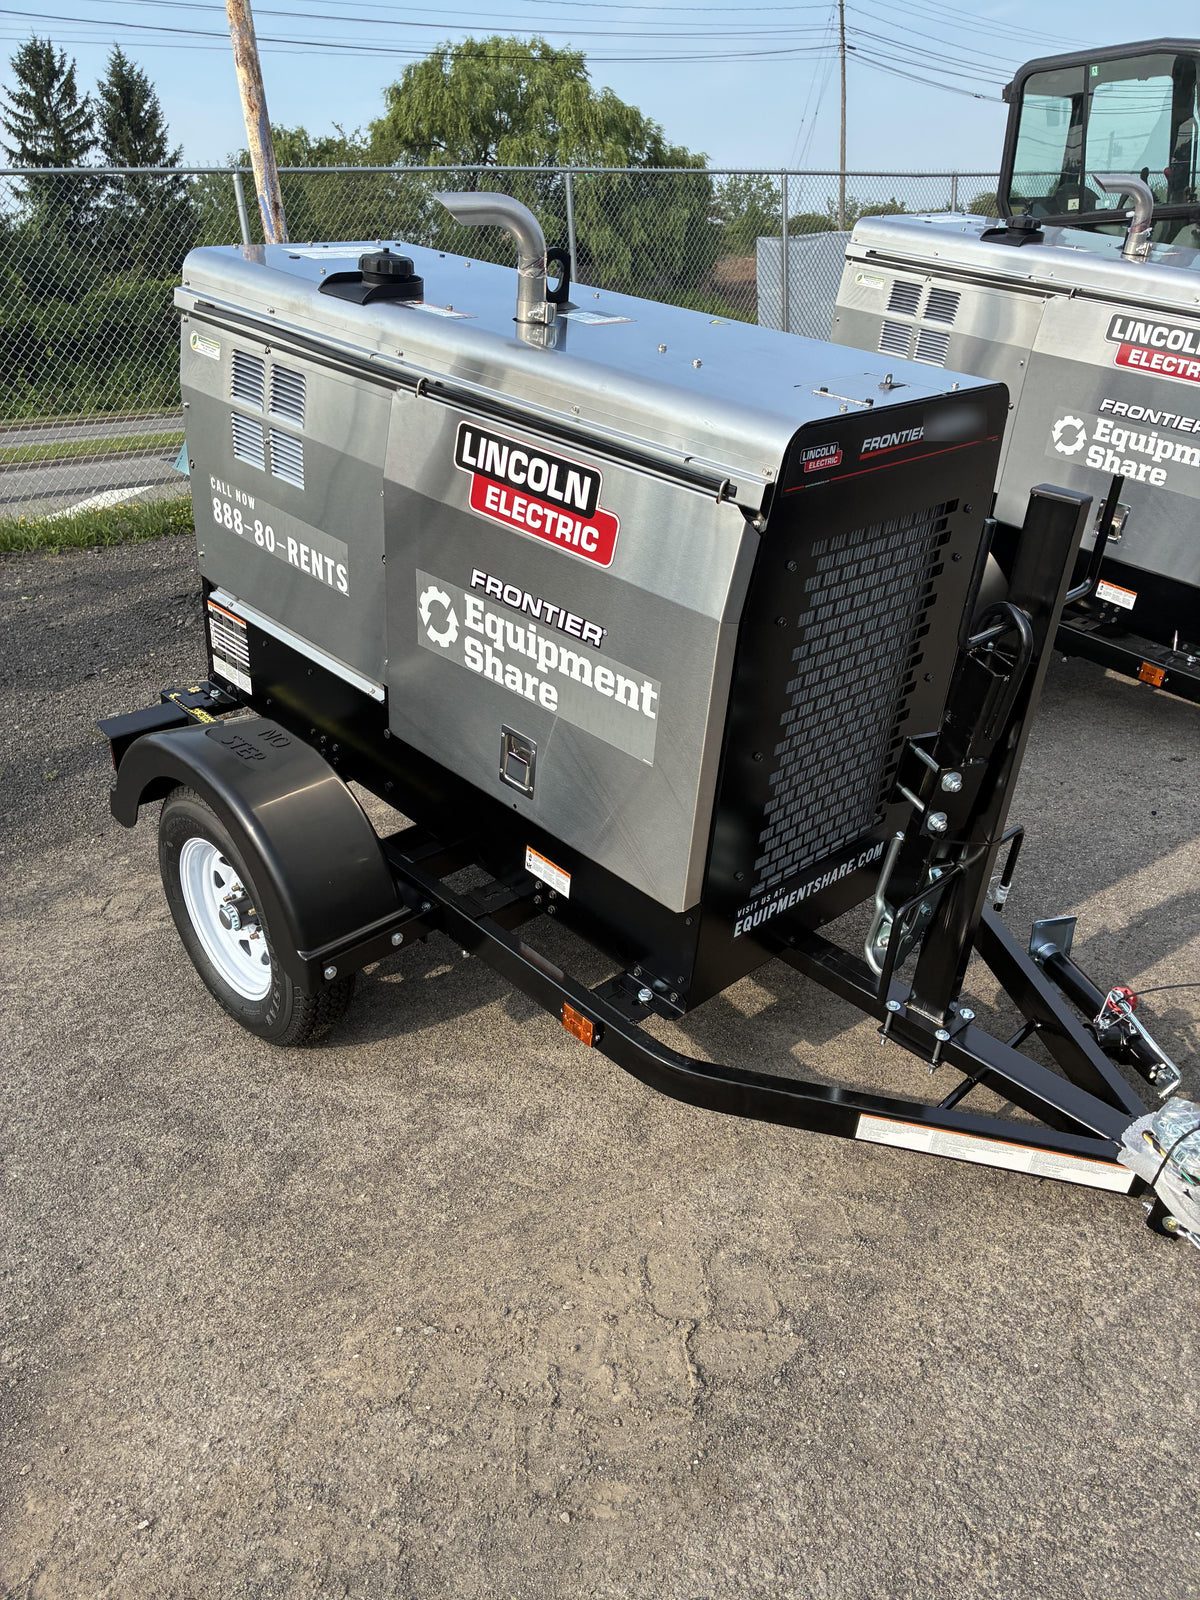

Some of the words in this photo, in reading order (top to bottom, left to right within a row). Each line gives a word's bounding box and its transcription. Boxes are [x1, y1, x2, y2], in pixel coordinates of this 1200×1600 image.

[1111, 318, 1200, 356] LINCOL
[1128, 349, 1200, 379] ELECTR
[462, 431, 592, 511] LINCOLN
[802, 444, 837, 461] LINCOLN
[808, 456, 838, 470] ELECTRIC
[1085, 444, 1168, 487] Share
[210, 476, 232, 498] CALL
[235, 489, 256, 510] NOW
[484, 484, 600, 553] ELECTRIC
[212, 497, 349, 593] 888-80-RENTS
[464, 593, 658, 720] Equipment
[464, 635, 558, 712] Share
[221, 735, 267, 760] STEP
[257, 729, 291, 748] NO
[733, 841, 885, 938] EQUIPMENTSHARE.COM
[737, 901, 759, 918] VISIT
[761, 894, 771, 905] US
[773, 887, 786, 899] AT:
